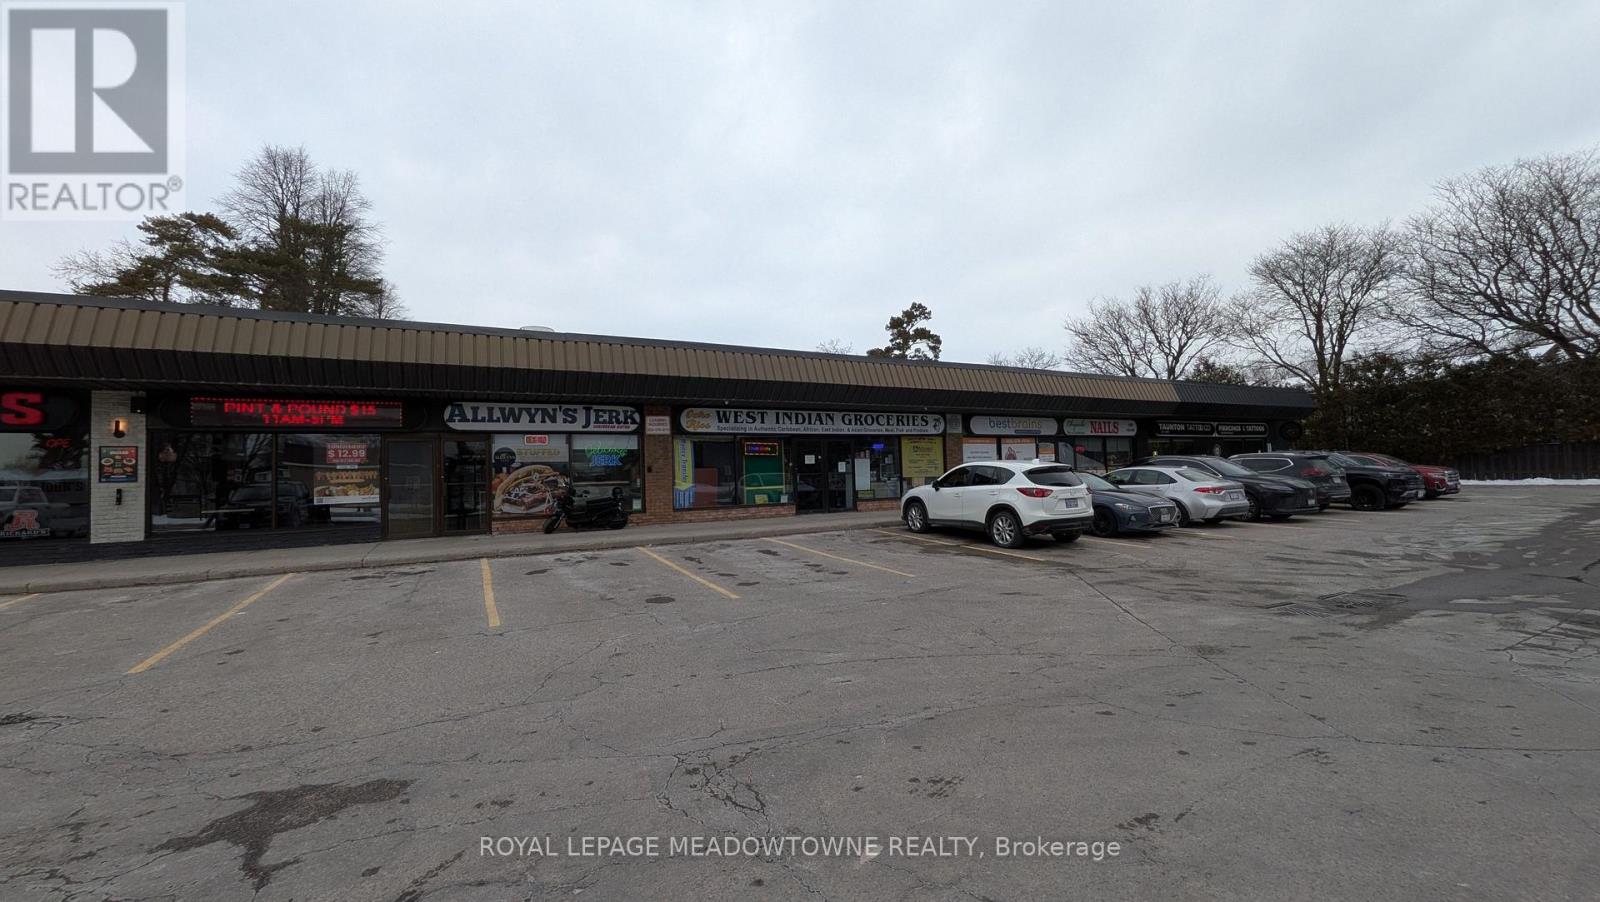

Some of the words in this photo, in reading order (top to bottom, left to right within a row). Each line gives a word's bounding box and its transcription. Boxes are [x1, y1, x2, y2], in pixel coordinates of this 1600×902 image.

[224, 403, 265, 413] PINT
[288, 404, 346, 415] POUND
[446, 404, 578, 425] ALLWYN'S
[582, 406, 640, 429] JERK
[715, 410, 769, 424] WEST
[775, 411, 835, 425] INDIAN
[841, 413, 929, 427] GROCERIES
[1090, 421, 1120, 434] NAILS
[1158, 423, 1185, 431] TAUNTON
